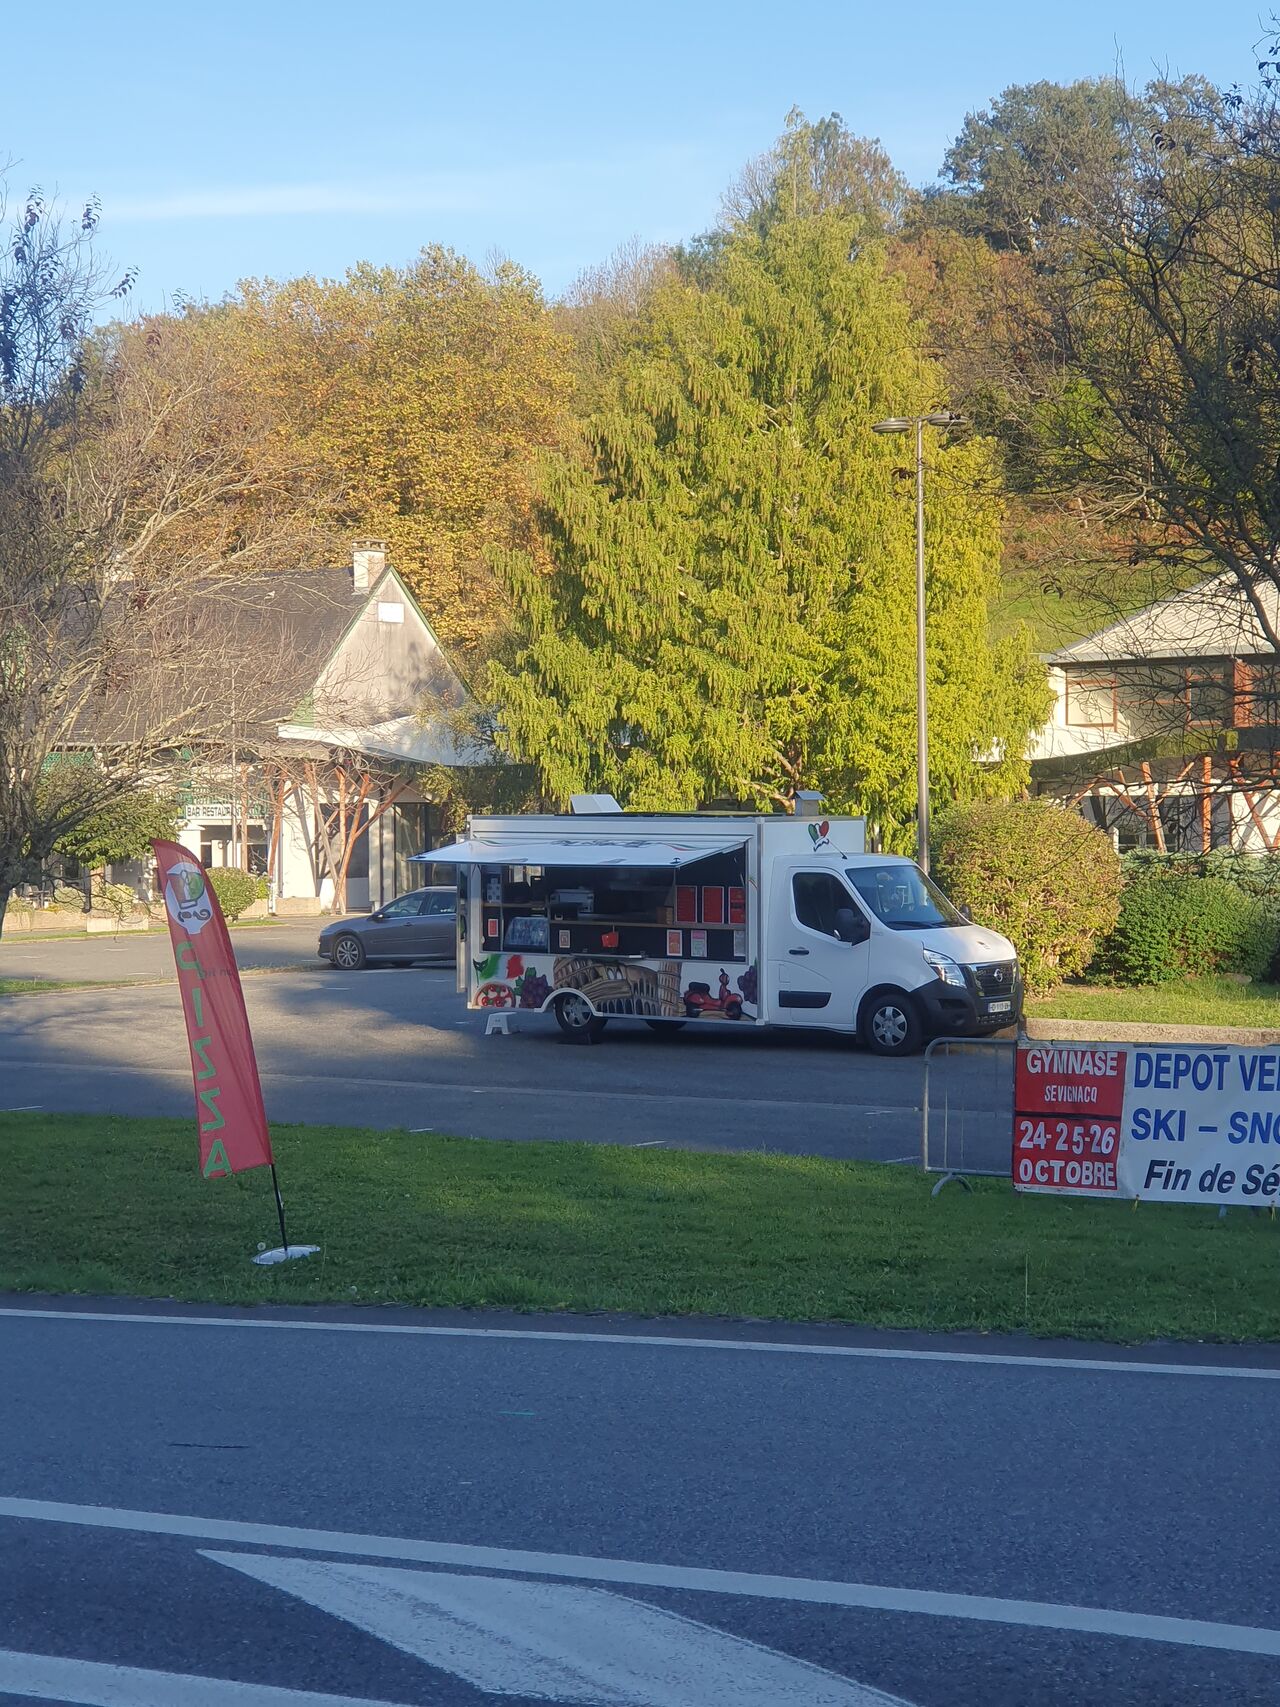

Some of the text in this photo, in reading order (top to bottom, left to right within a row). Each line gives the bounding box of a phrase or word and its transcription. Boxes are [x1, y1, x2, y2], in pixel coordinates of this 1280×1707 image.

[187, 806, 243, 817] BAR RESTAURNT
[1027, 1049, 1118, 1076] GYMNASE
[1134, 1052, 1280, 1092] DEPOT VE
[1044, 1085, 1098, 1104] SEVIGNACQ
[1131, 1107, 1187, 1142] SKI
[1019, 1158, 1116, 1187] OCTOBRE
[1144, 1159, 1280, 1196] Fin de Sé
